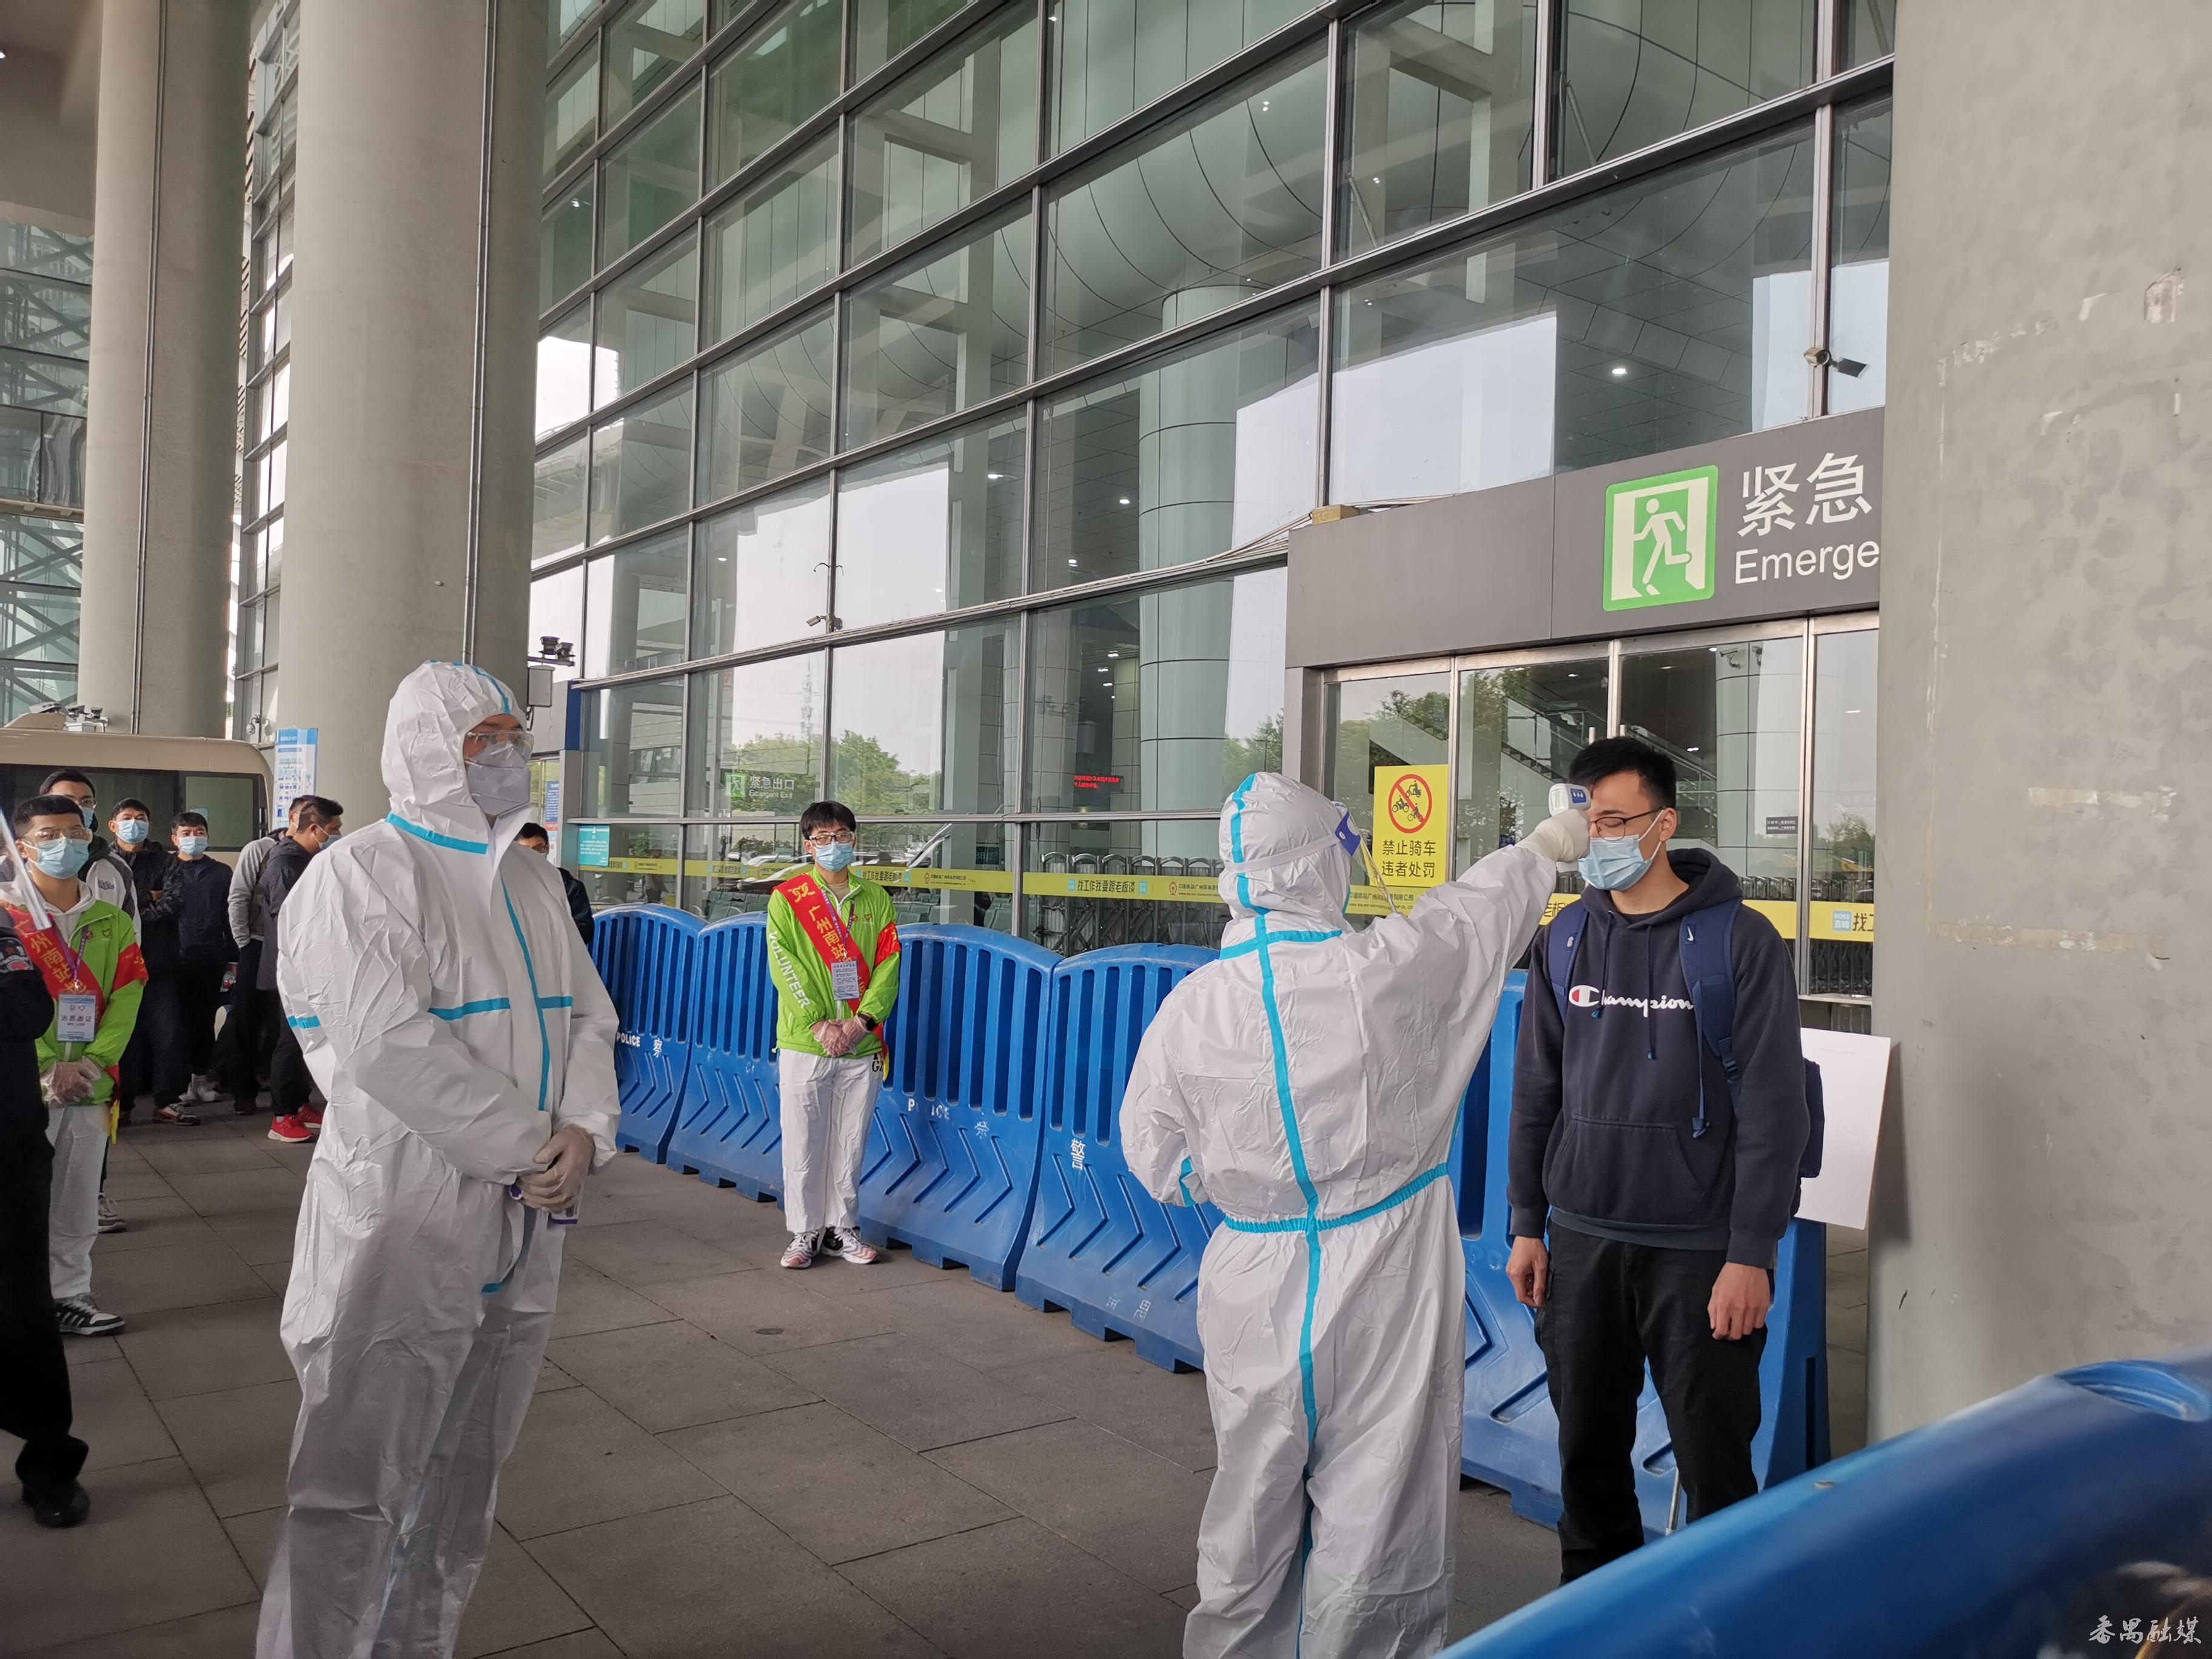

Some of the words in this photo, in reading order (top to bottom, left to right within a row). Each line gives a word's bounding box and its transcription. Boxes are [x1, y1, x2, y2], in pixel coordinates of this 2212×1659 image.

[1737, 452, 1872, 537] 紧急
[1735, 541, 1880, 584] Emerge
[749, 776, 794, 790] 紧急出口
[1382, 840, 1436, 856] 禁止骑车
[1382, 860, 1435, 878] 违者处罚
[768, 931, 811, 1009] VOLUNTEER
[1569, 985, 1694, 1017] Champion
[617, 1032, 640, 1048] POLICE
[652, 1037, 663, 1057] 察
[1071, 1138, 1085, 1170] 警
